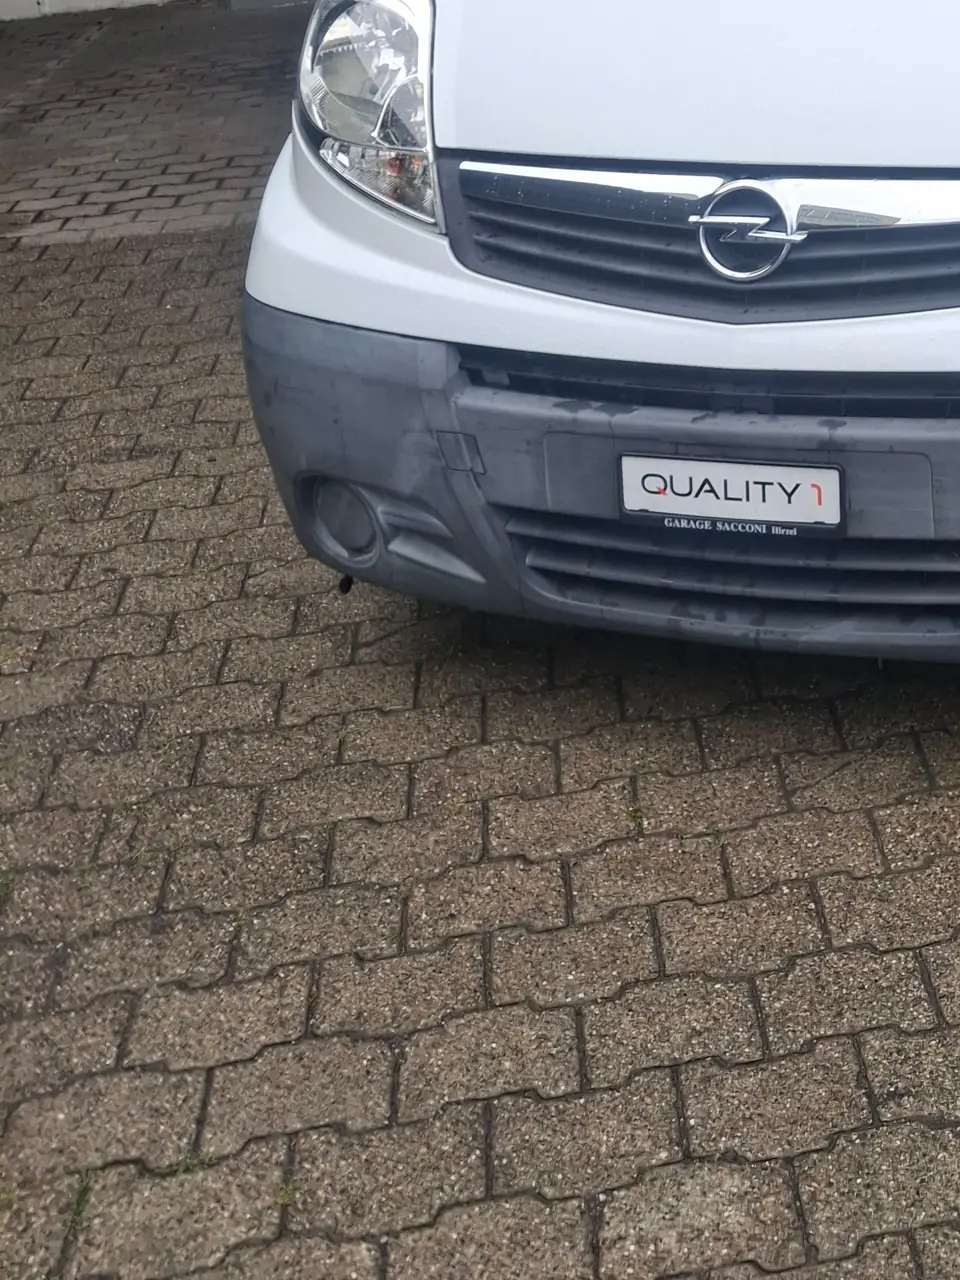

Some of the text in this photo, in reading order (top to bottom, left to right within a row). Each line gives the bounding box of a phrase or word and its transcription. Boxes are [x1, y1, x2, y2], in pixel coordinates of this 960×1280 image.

[640, 473, 801, 505] QUALITY
[664, 517, 713, 530] GARAGE
[716, 521, 767, 534] SACCONI
